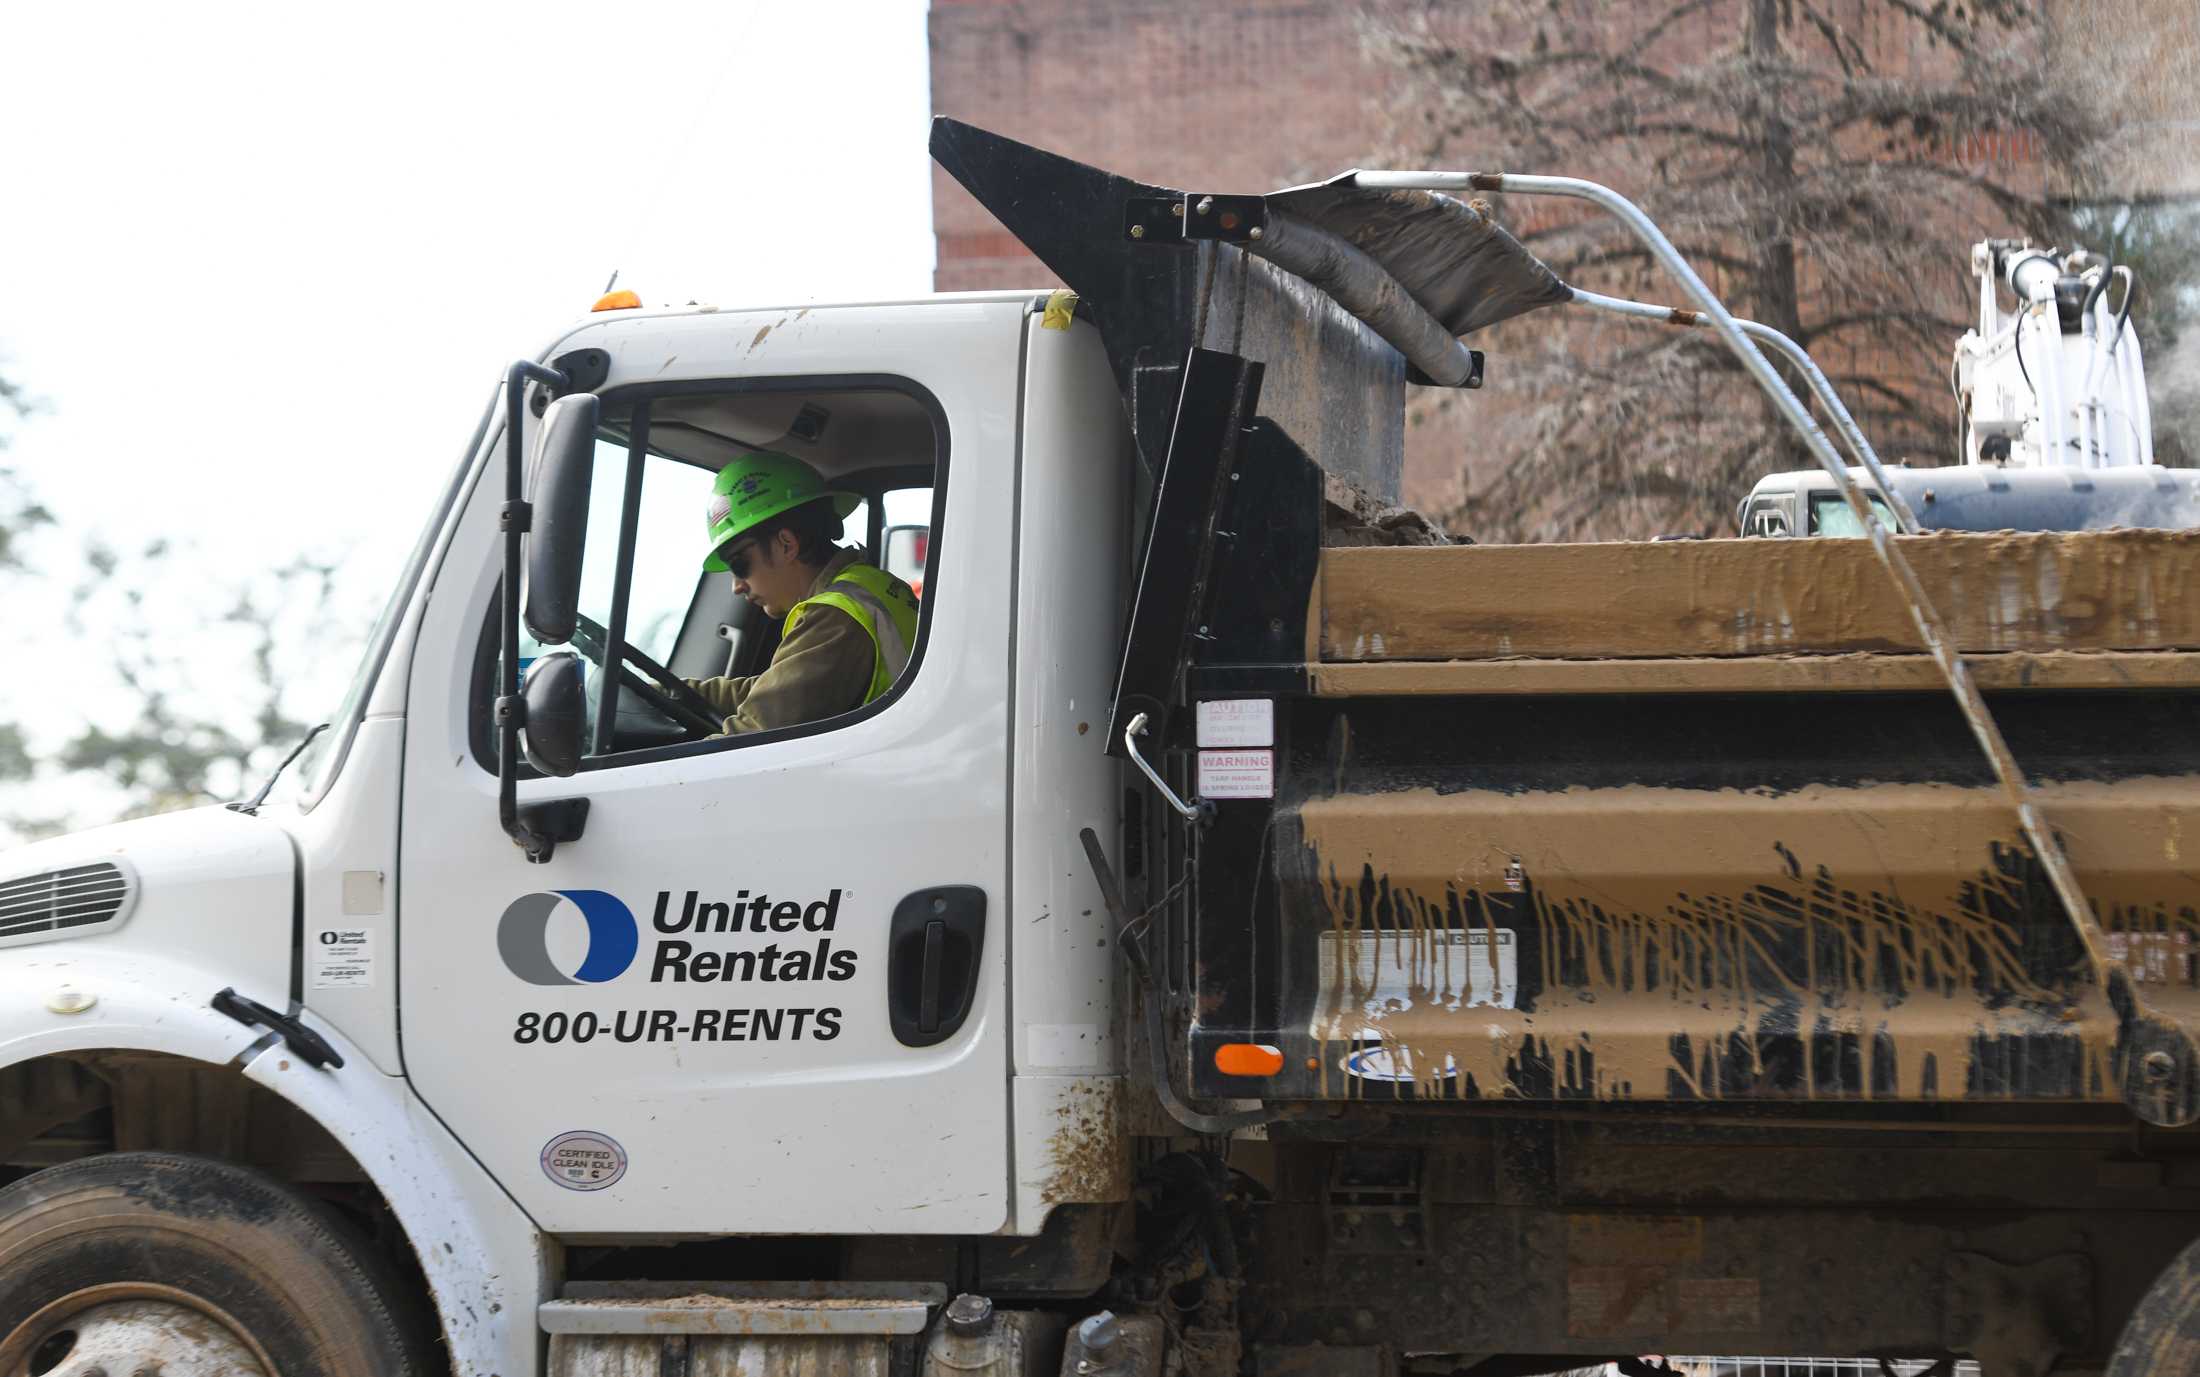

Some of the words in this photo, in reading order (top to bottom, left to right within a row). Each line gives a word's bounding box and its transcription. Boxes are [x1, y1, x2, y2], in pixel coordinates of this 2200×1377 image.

[1202, 702, 1269, 713] AUTION
[1202, 756, 1270, 767] WARNING
[652, 889, 842, 934] United
[1454, 934, 1506, 945] CUTIN
[650, 938, 858, 983] Rentals
[513, 1007, 843, 1044] 800-UR-RENTS
[558, 1149, 610, 1160] CERTIFIED
[553, 1160, 588, 1168] CLEAN
[591, 1161, 615, 1170] IDLE
